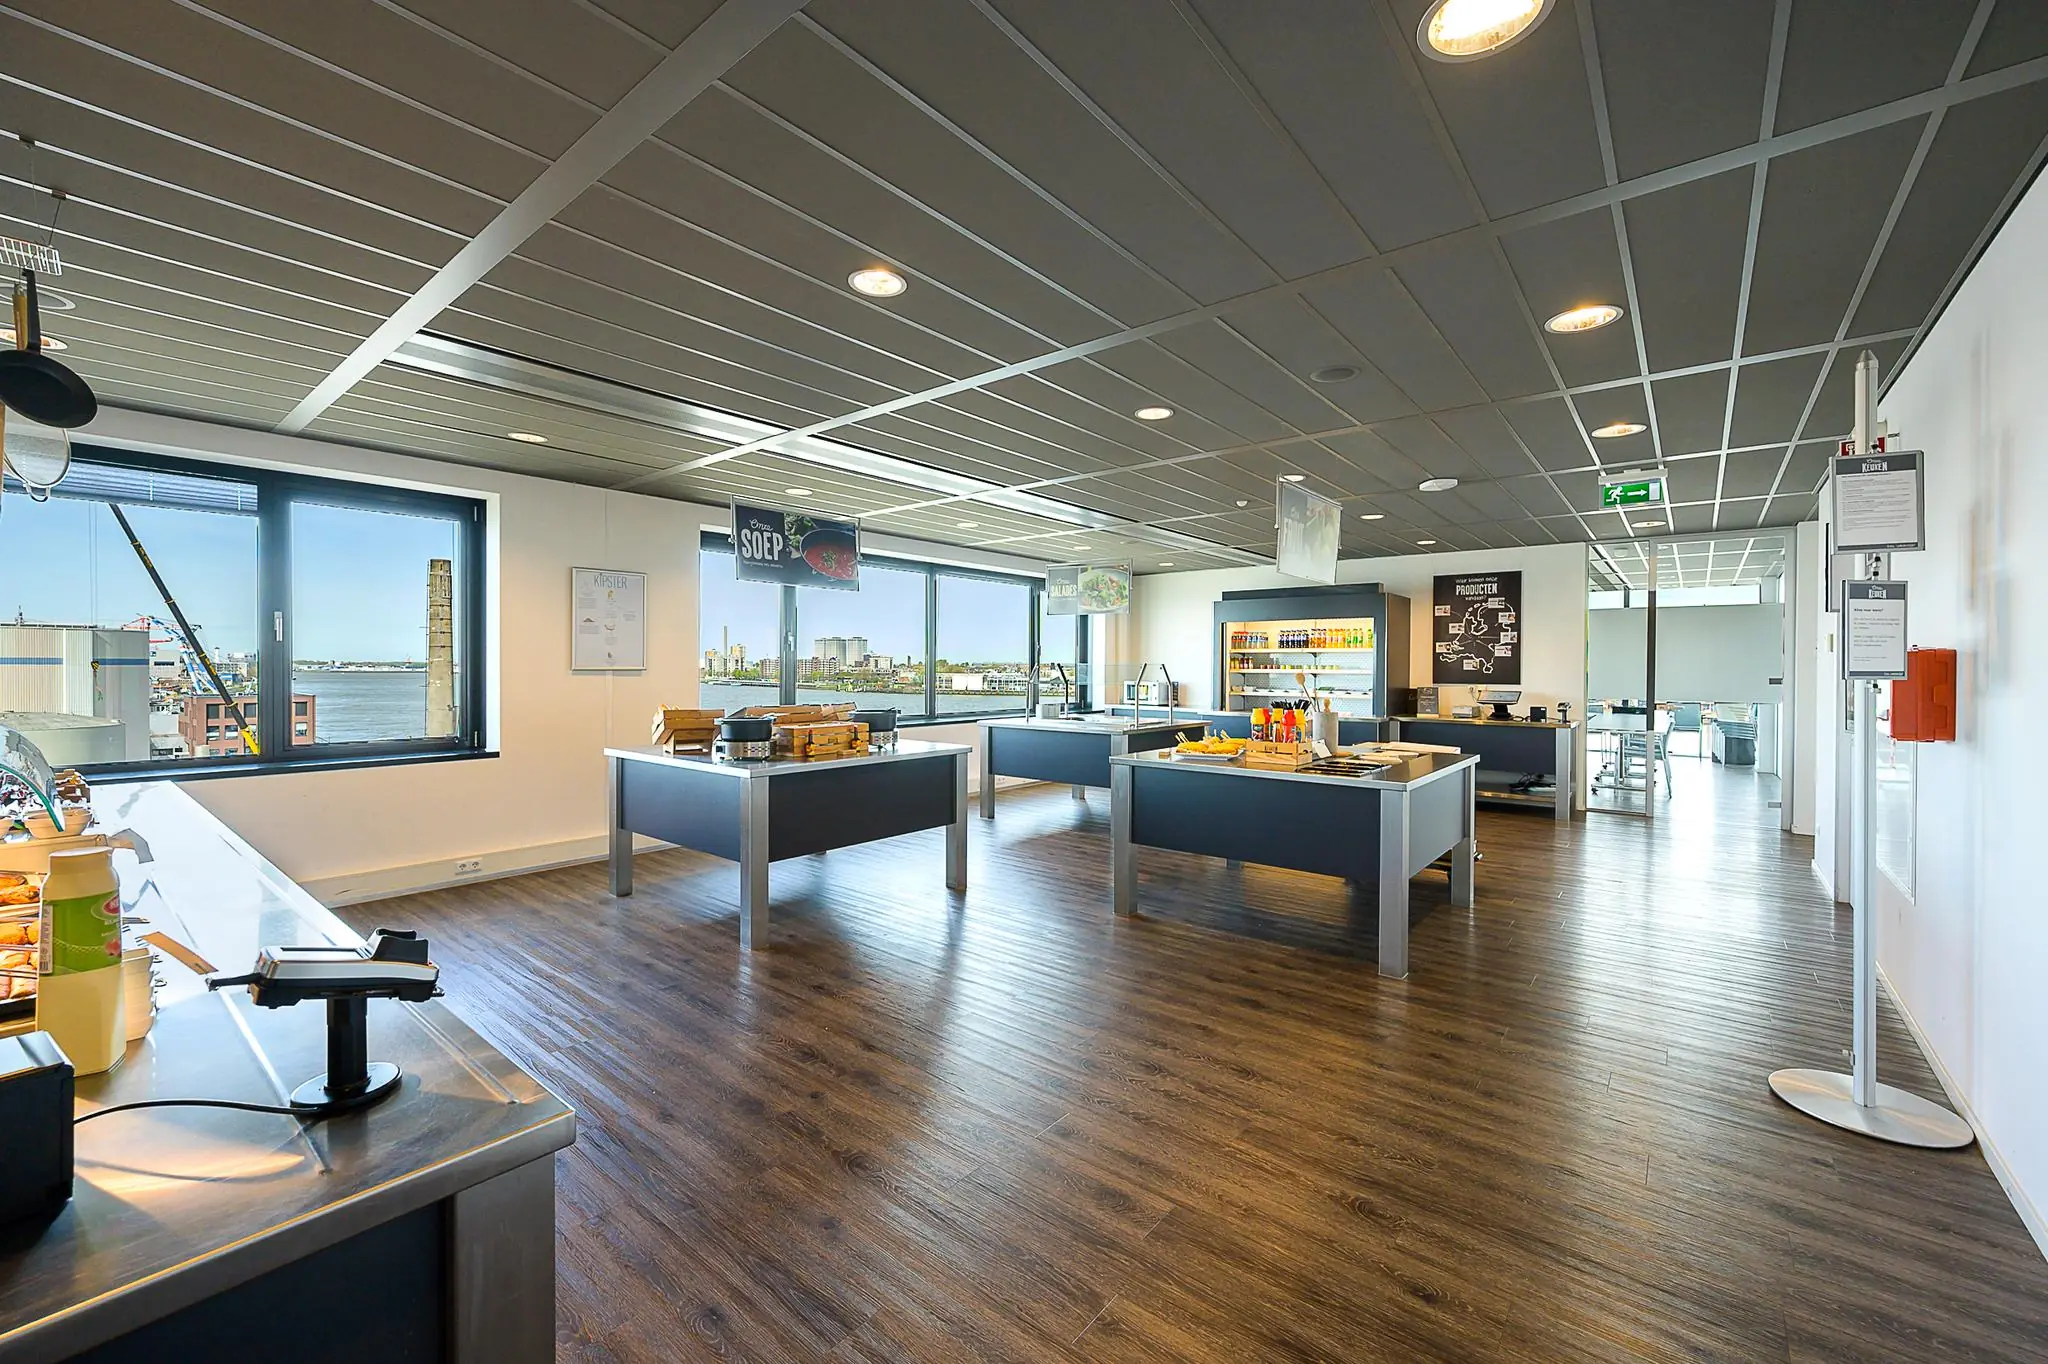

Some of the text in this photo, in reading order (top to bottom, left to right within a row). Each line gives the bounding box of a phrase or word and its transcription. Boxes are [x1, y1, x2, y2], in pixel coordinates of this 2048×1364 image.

[1862, 461, 1888, 473] KEUKEN
[741, 528, 783, 561] SOEP
[593, 573, 628, 589] KIPSTER
[1051, 584, 1078, 597] SALADES
[1456, 583, 1498, 596] PRODUCTEN
